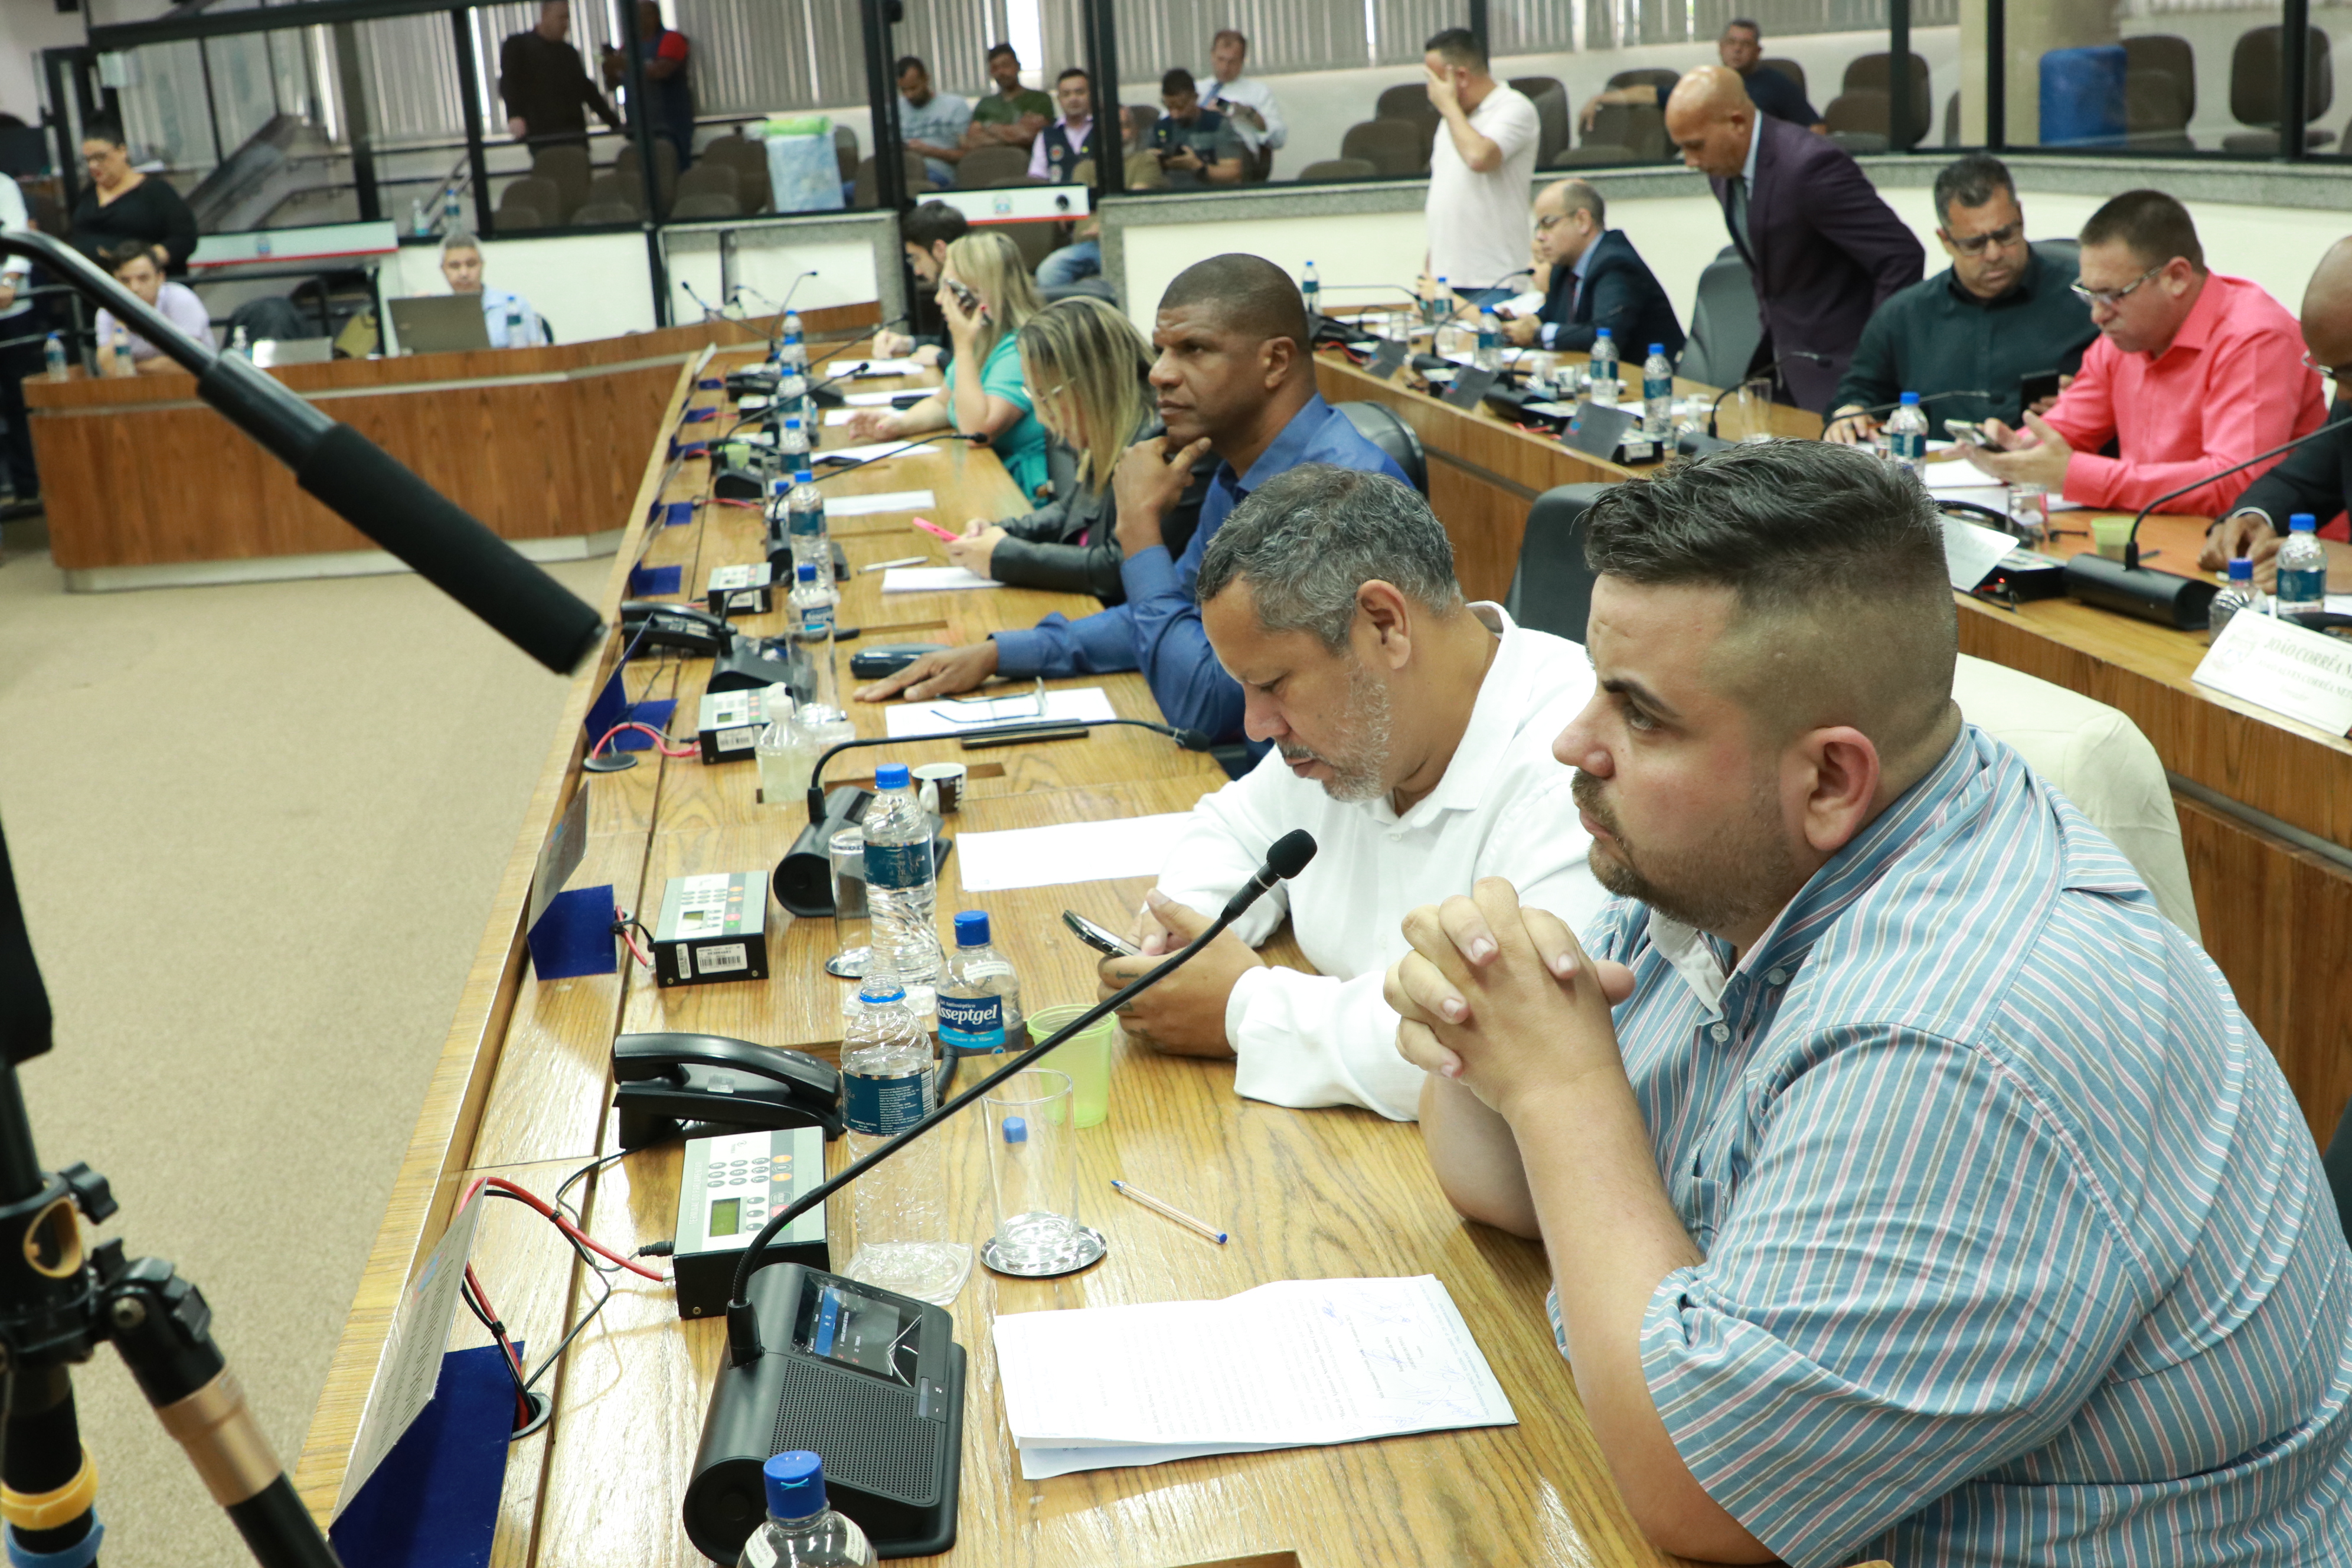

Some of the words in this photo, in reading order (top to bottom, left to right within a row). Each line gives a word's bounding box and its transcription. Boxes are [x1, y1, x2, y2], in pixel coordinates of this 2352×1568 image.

[693, 1161, 703, 1193] PARLAMENTAR
[688, 1201, 699, 1224] TERMINAL
[420, 1259, 453, 1350] GORDINHO
[413, 1340, 433, 1377] DO
[398, 1366, 426, 1426] POVO
